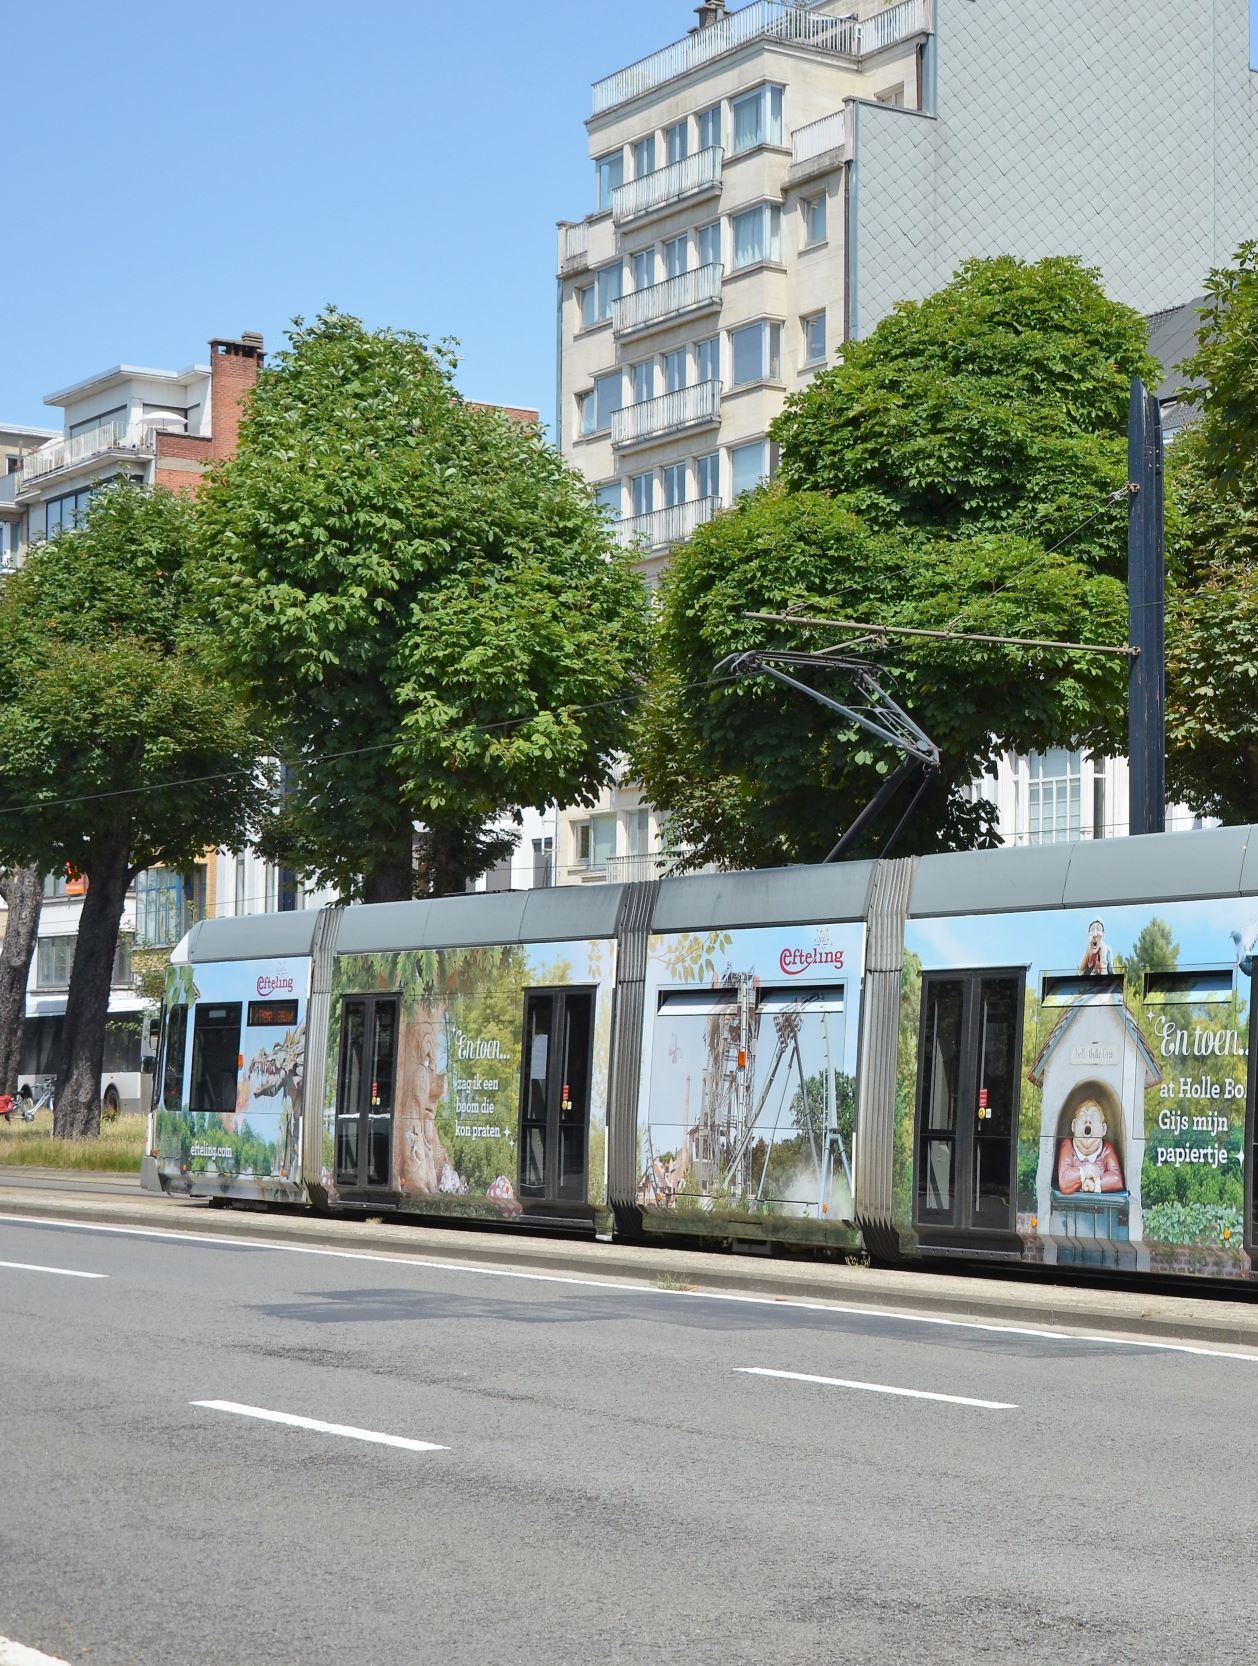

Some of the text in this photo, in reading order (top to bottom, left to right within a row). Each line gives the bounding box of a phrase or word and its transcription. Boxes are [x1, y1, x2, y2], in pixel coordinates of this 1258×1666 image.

[455, 1029, 474, 1060] En
[1154, 1015, 1190, 1057] En
[456, 1074, 499, 1093] zag ik een
[1159, 1081, 1175, 1098] at
[1178, 1076, 1221, 1099] Holle
[456, 1096, 495, 1113] boom die
[454, 1120, 501, 1141] kon praten
[1158, 1109, 1229, 1136] Gijs mijn
[190, 1140, 233, 1161] efteling.com
[1156, 1142, 1228, 1169] papiertje
